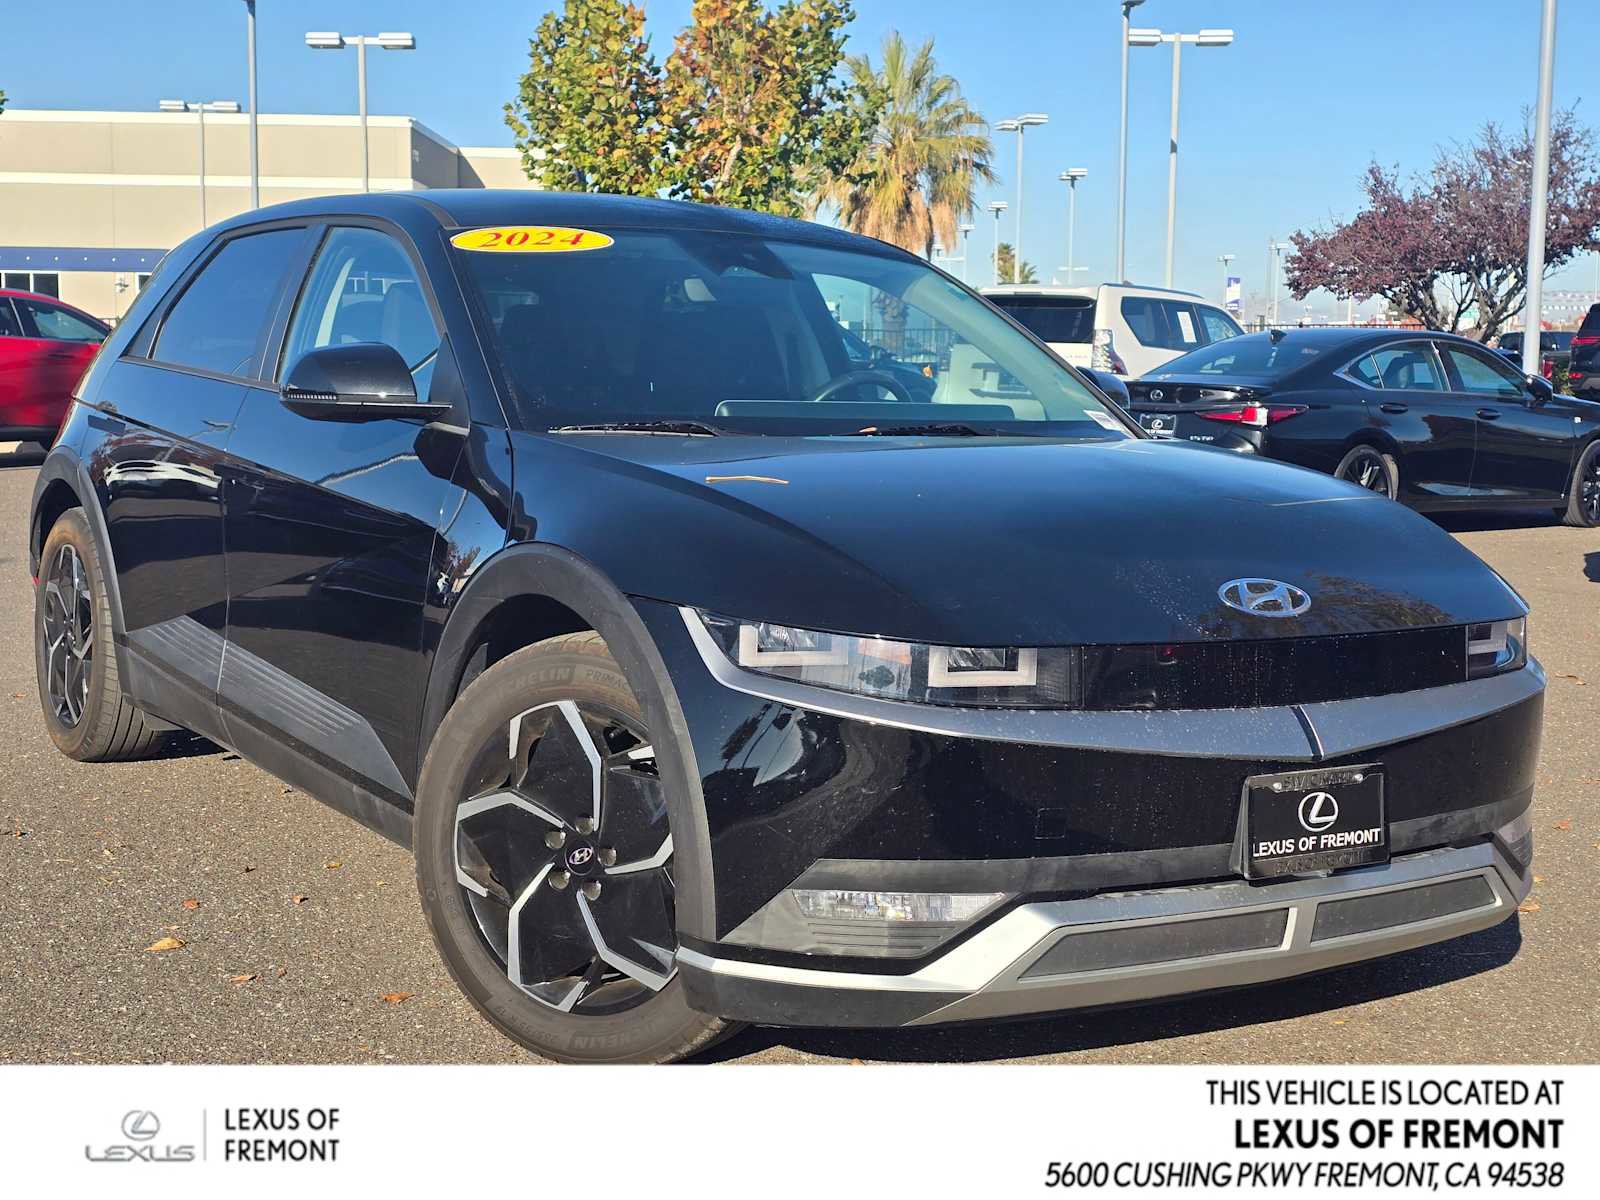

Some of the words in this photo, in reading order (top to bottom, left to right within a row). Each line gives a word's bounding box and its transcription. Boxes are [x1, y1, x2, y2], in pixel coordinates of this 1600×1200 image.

[478, 231, 586, 248] 2024
[1252, 839, 1295, 857] LEXUS
[1298, 836, 1318, 852] OF
[1320, 828, 1381, 849] FREMONT
